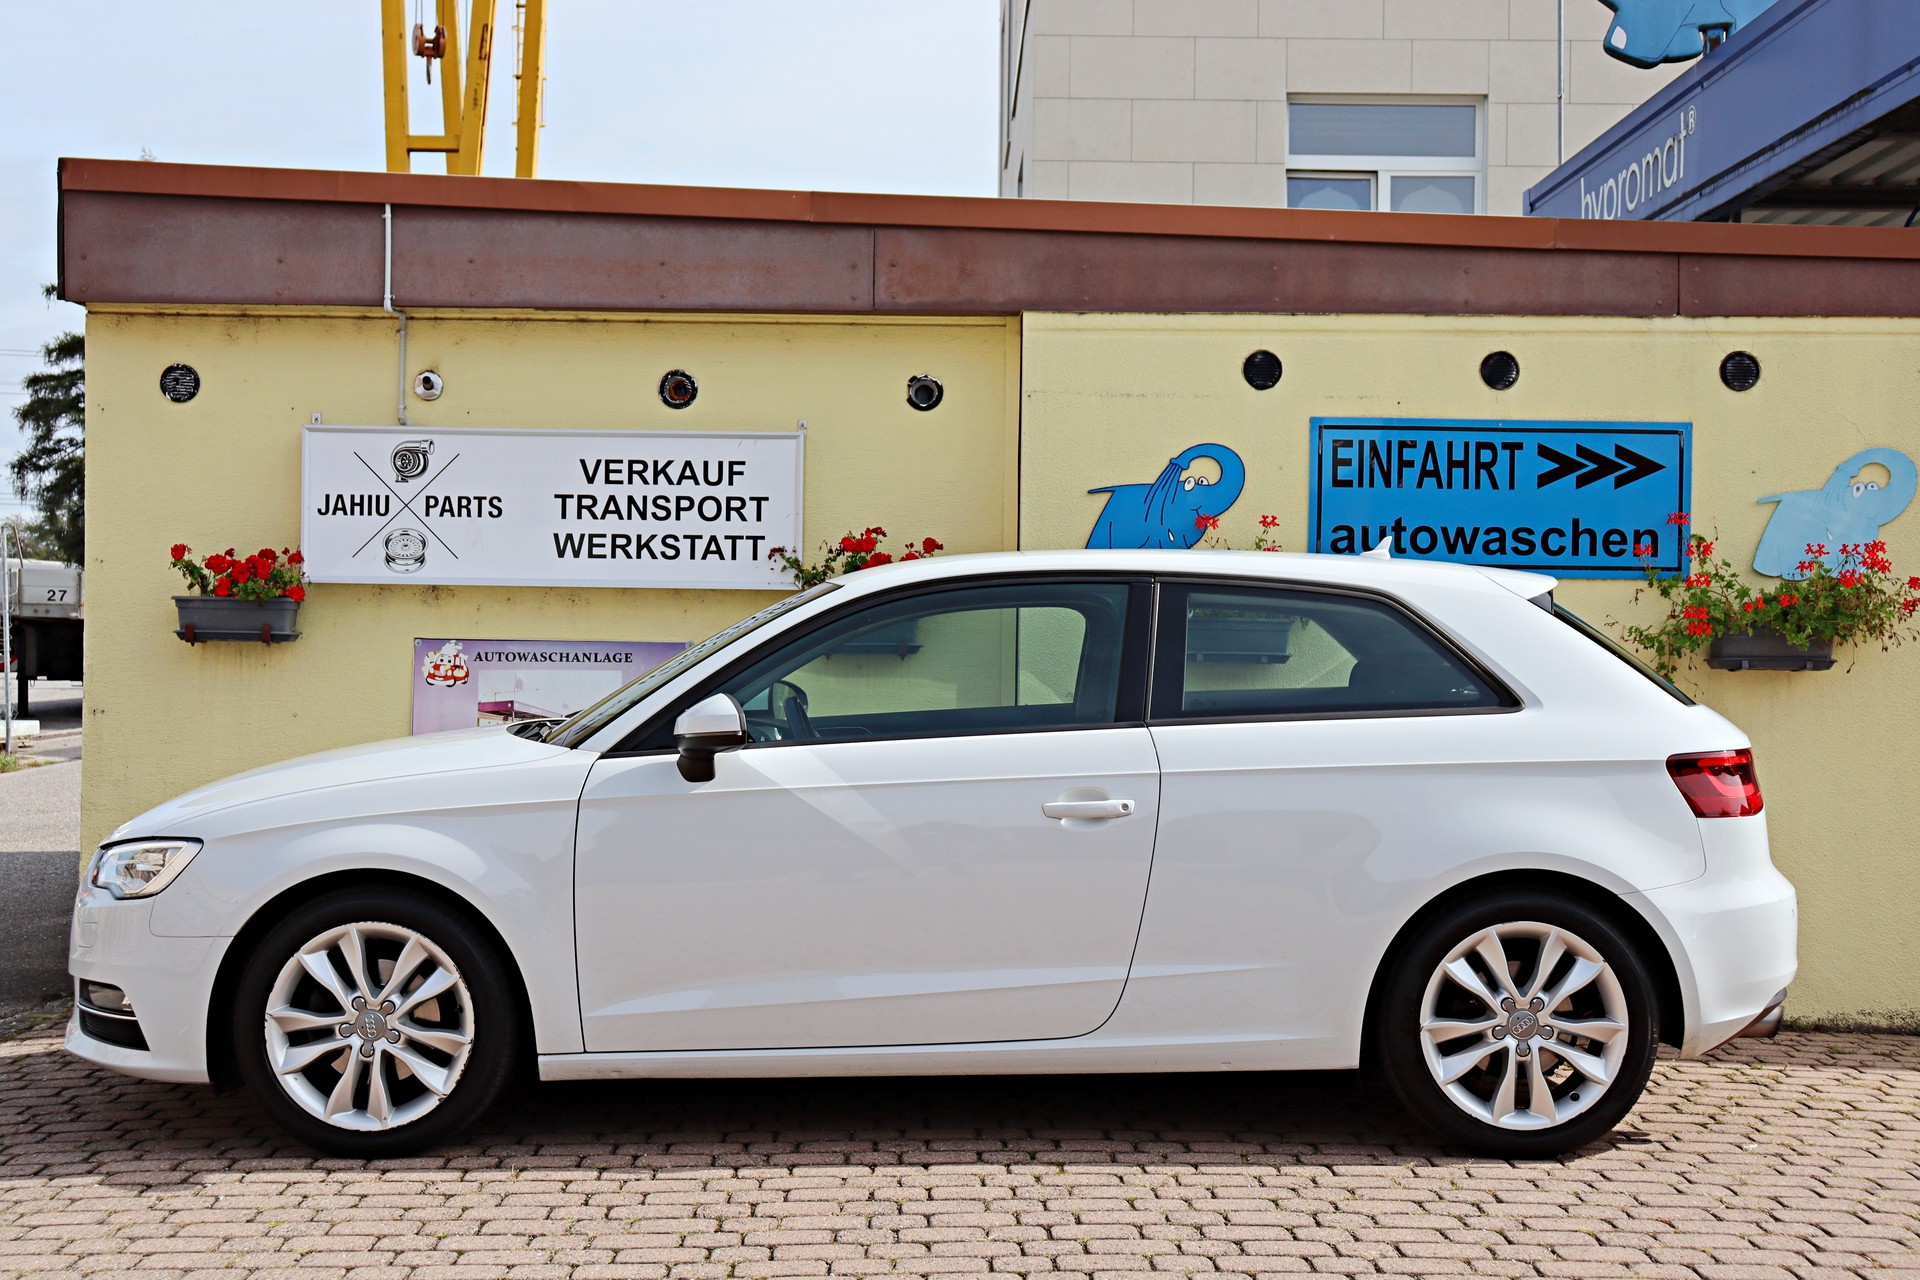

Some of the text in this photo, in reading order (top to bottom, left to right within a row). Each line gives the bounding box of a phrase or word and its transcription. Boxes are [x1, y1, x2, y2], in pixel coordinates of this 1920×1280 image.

[579, 458, 746, 487] VERKAUF
[1331, 438, 1524, 490] EINFAHRT
[317, 493, 503, 519] JAHIU PARTS
[553, 493, 770, 522] TRANSPORT
[552, 532, 766, 561] WERKSTATT
[1329, 516, 1659, 558] autowaschen
[46, 589, 68, 602] 27
[473, 651, 633, 664] AUTOWASCHANLAGE
